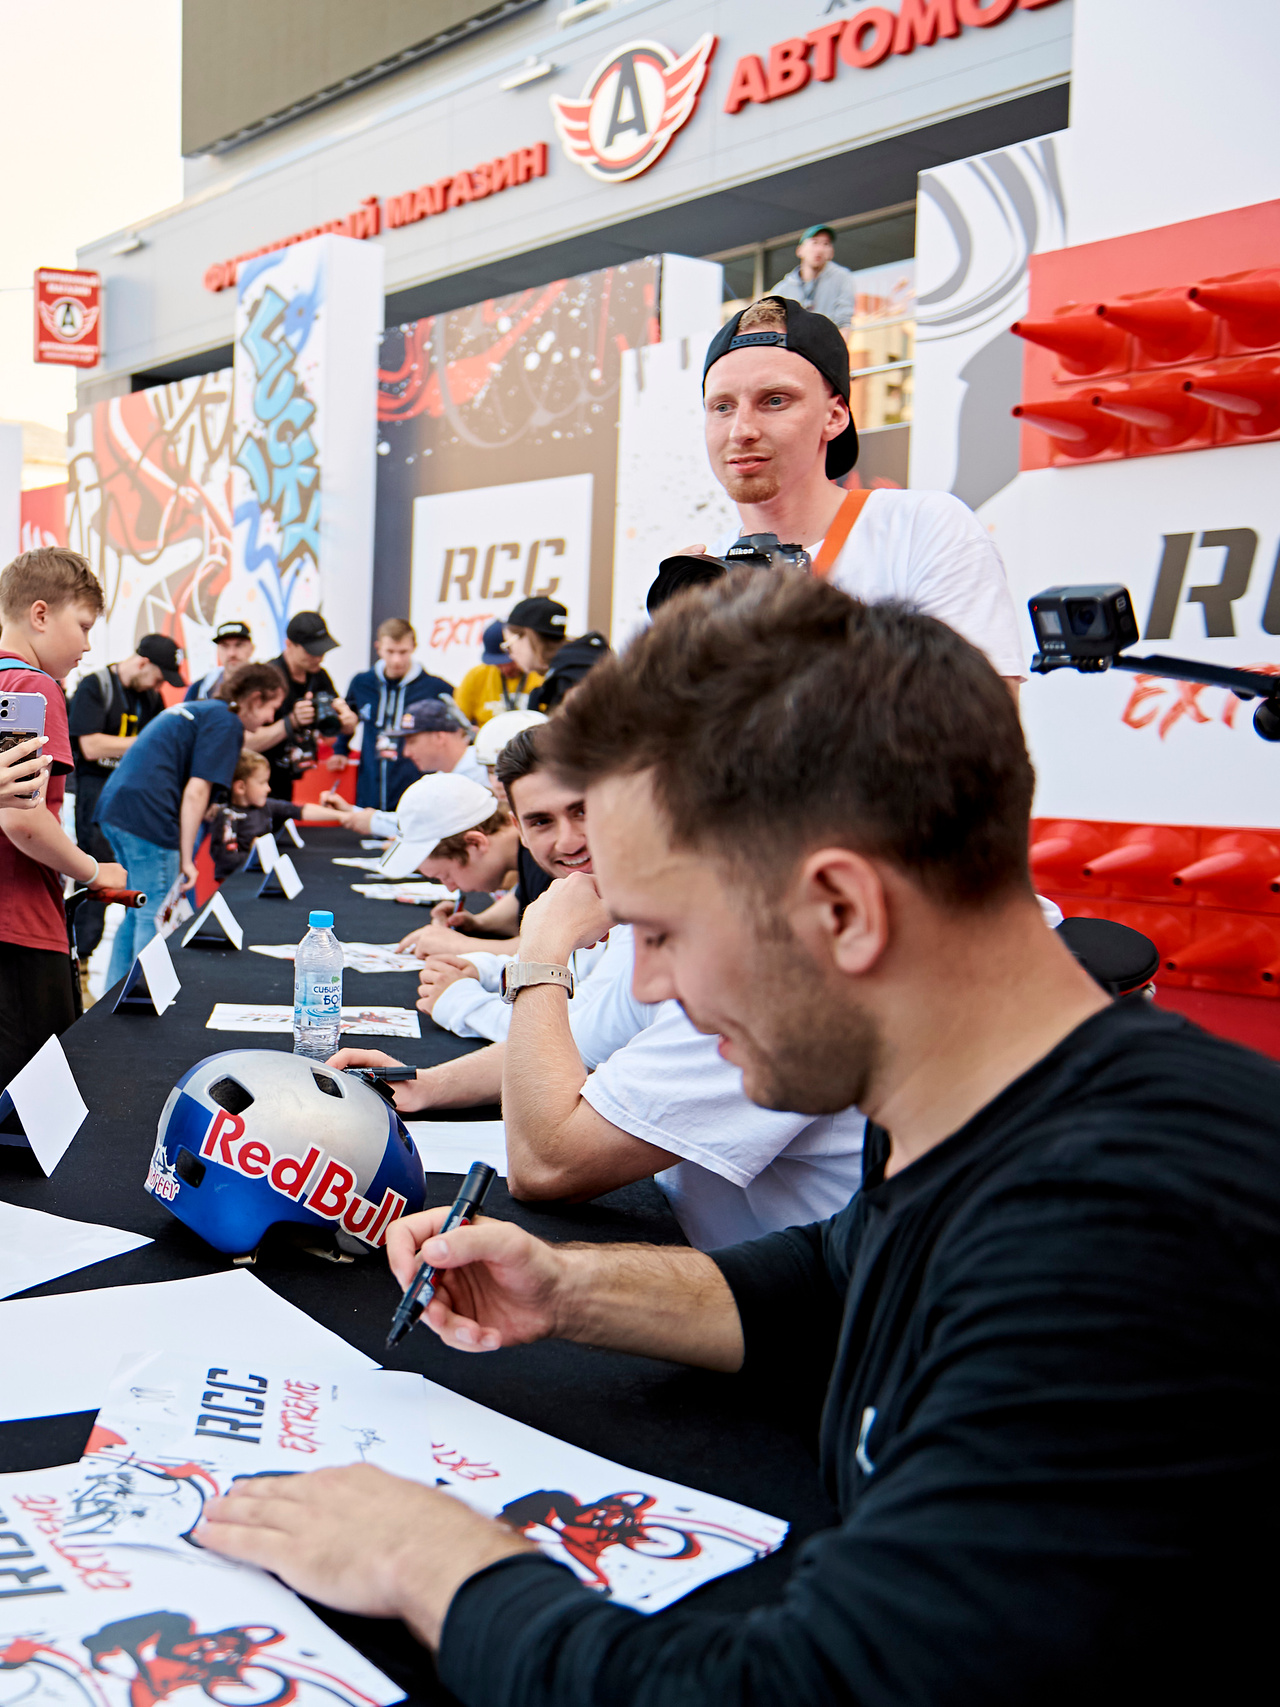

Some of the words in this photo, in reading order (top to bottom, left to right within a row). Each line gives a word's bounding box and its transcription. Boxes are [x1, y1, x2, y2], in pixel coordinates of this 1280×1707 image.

[723, 0, 1064, 115] АВТОМ
[385, 141, 549, 229] МАГАЗИН
[437, 538, 566, 602] RCC
[729, 547, 754, 556] Nikon
[1143, 527, 1280, 640] R
[195, 1367, 268, 1444] RCC
[278, 1378, 324, 1453] EXTREME
